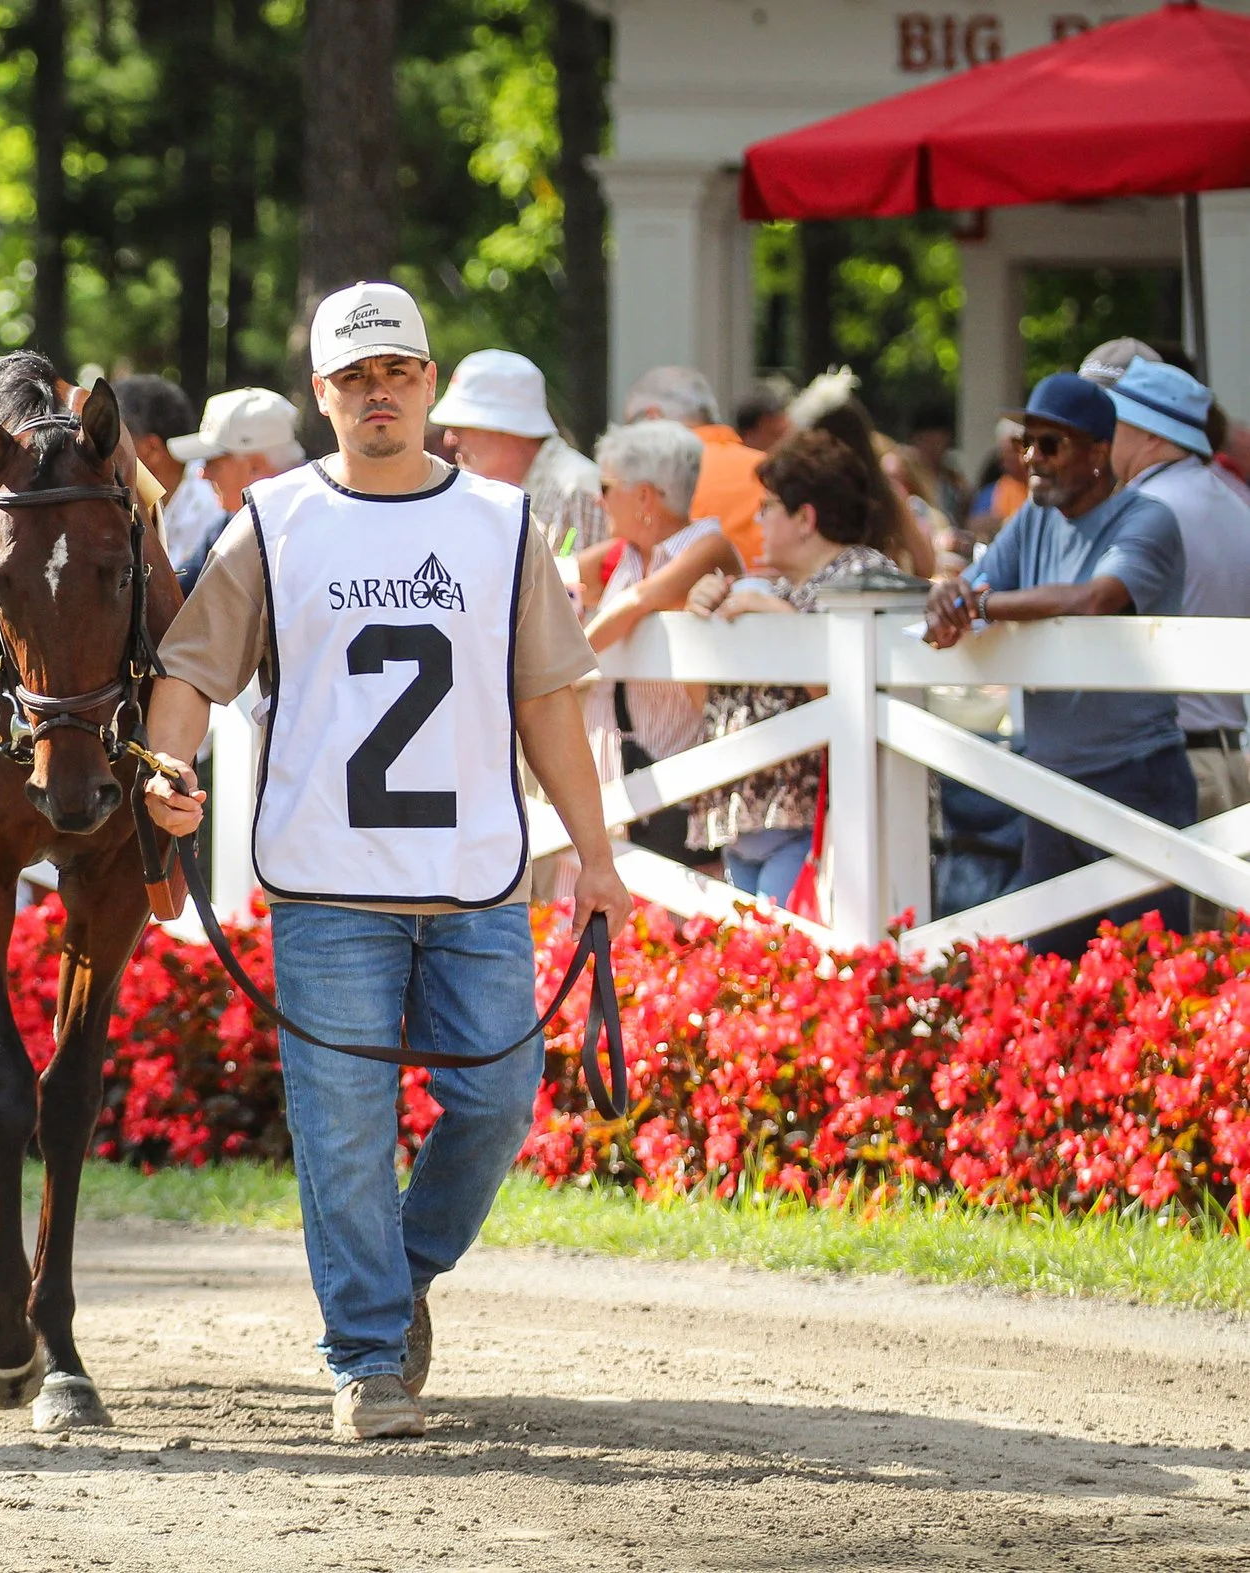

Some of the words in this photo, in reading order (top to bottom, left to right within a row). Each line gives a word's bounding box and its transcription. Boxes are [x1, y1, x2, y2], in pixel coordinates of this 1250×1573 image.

[898, 13, 1004, 72] BIG
[335, 320, 401, 338] REALTREE
[345, 303, 381, 323] Team
[328, 578, 467, 613] SARATOGA
[346, 623, 456, 828] 2
